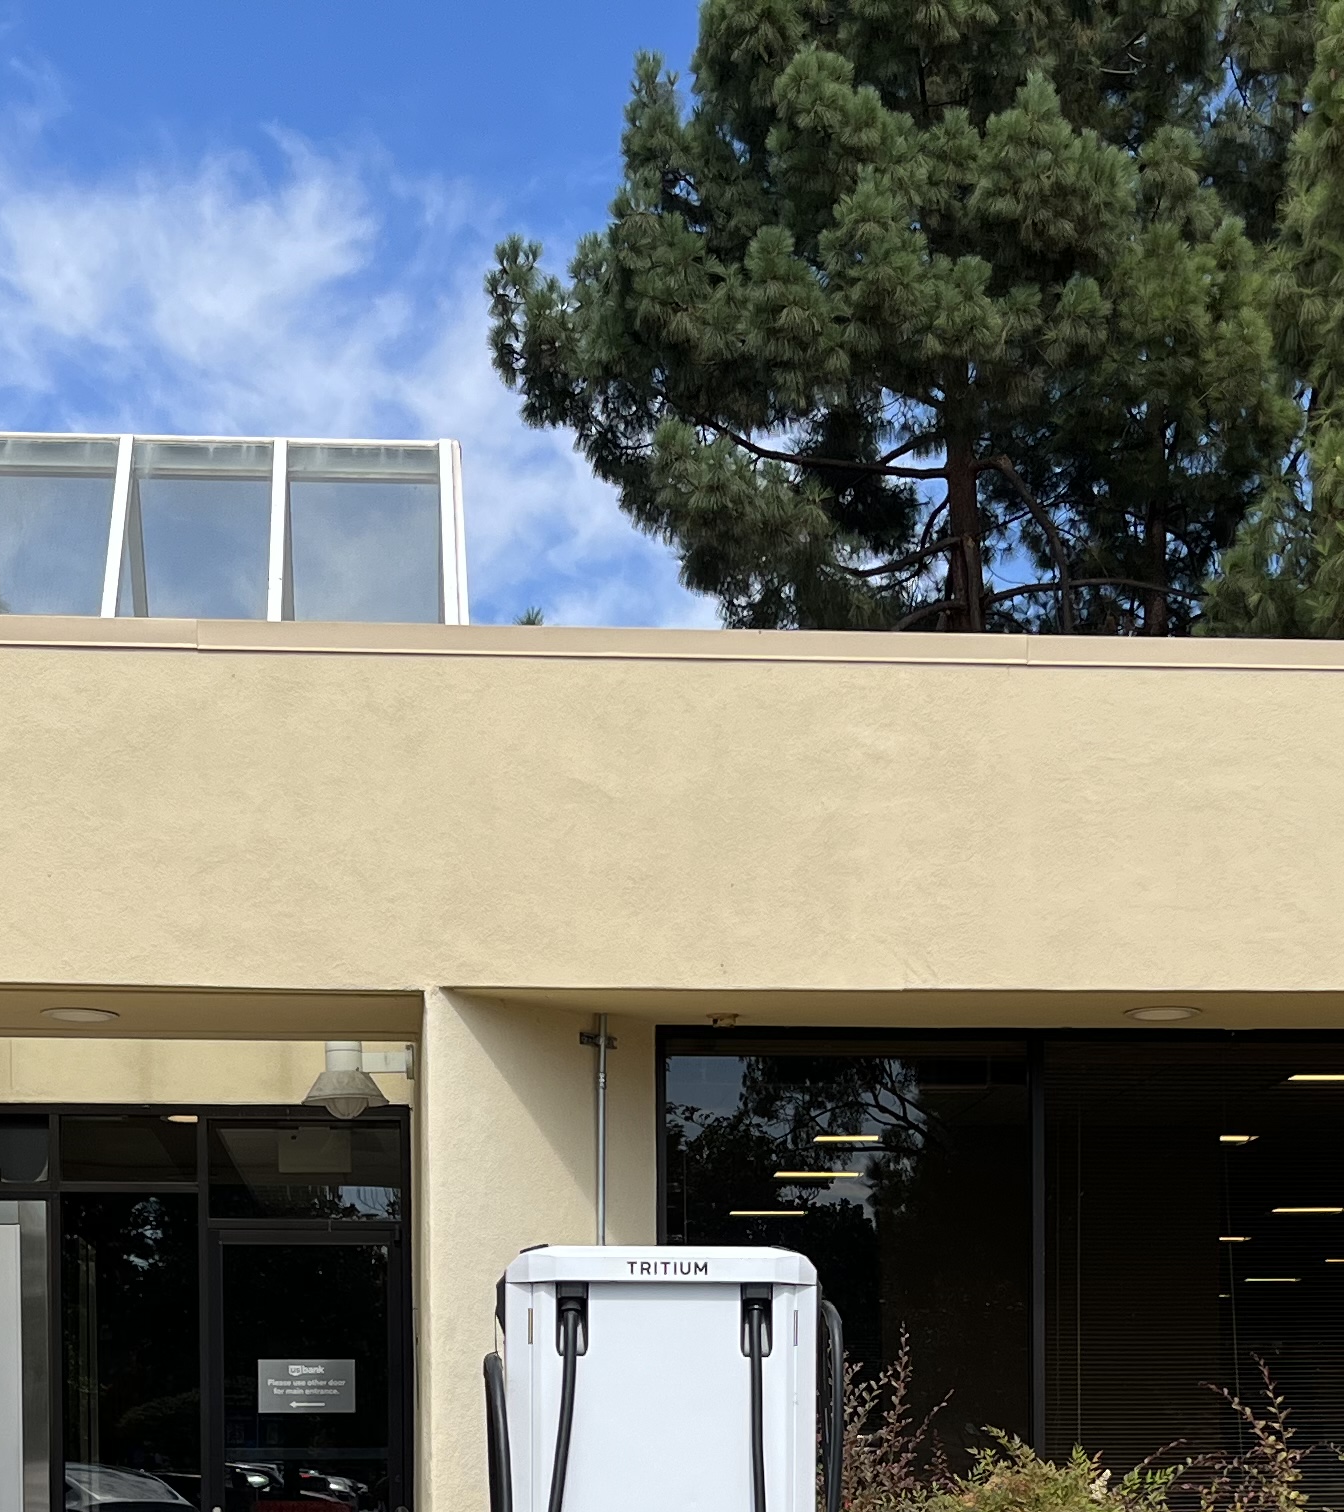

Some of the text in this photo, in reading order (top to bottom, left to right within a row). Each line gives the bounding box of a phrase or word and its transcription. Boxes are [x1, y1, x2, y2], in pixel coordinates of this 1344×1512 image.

[627, 1261, 708, 1276] TRITIUM
[302, 1365, 325, 1374] bank
[273, 1387, 285, 1395] for
[285, 1387, 304, 1395] main
